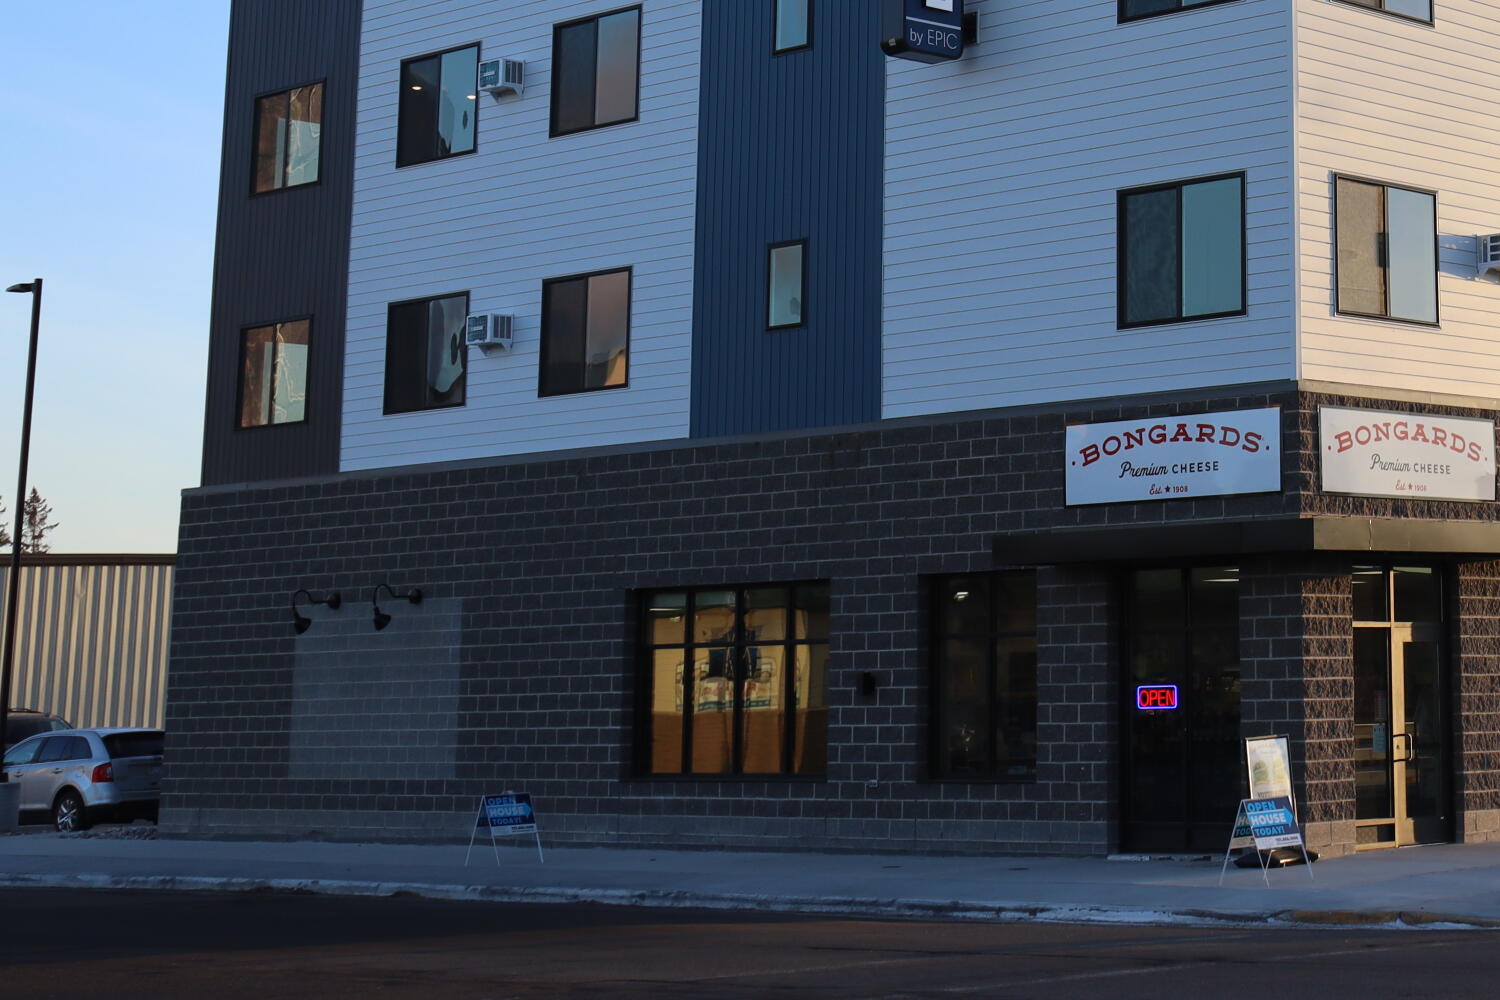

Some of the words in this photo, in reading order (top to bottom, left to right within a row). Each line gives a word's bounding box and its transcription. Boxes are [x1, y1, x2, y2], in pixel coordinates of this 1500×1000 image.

[910, 28, 924, 46] by
[927, 29, 958, 50] EPIC
[1079, 423, 1262, 467] BONGARDS
[1335, 421, 1482, 462] BONGARDS
[1118, 461, 1169, 479] Premium
[1171, 461, 1220, 474] CHEESE
[1370, 453, 1411, 472] Premium
[1413, 462, 1451, 475] CHEESE
[1172, 485, 1189, 493] 1908
[1140, 689, 1175, 707] OPEN
[487, 796, 516, 806] OPEN
[1247, 801, 1276, 812] OPEN
[489, 805, 525, 818] HOUSE
[1250, 812, 1287, 825] HOUSE
[1255, 825, 1285, 837] TODAY!
